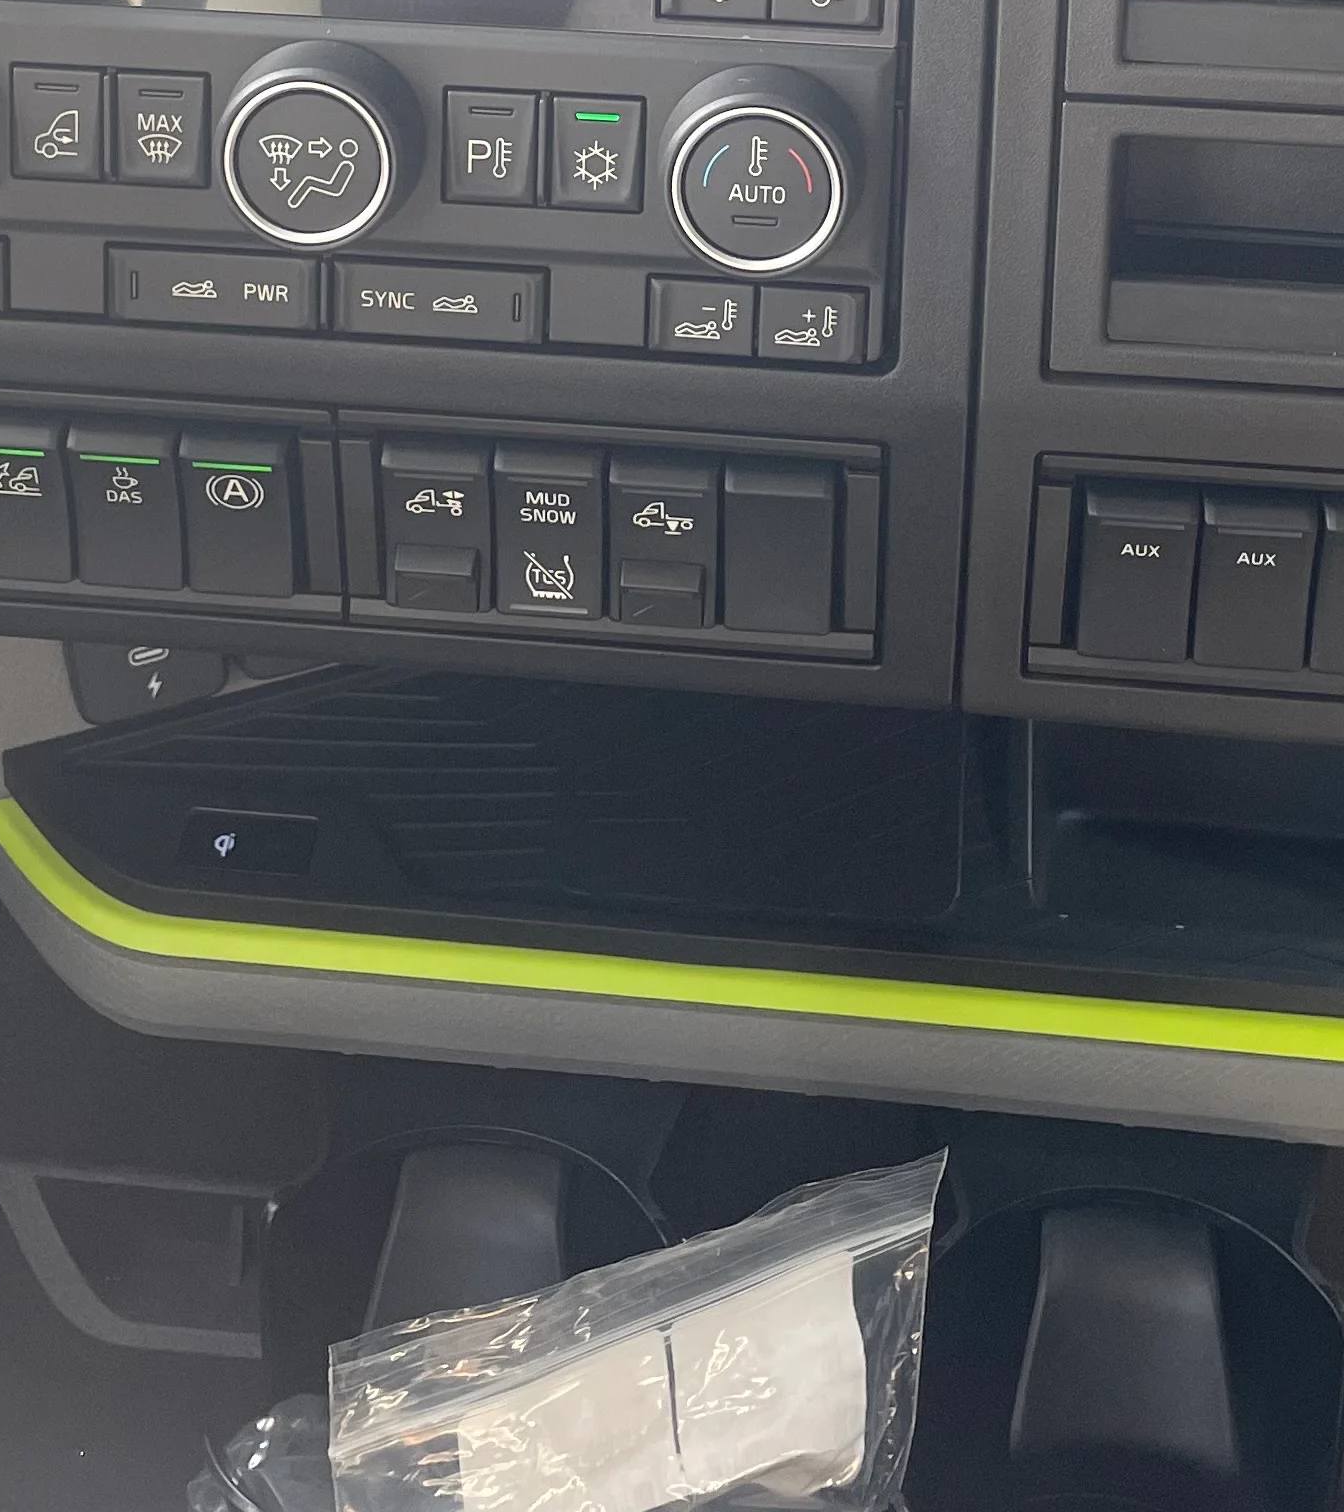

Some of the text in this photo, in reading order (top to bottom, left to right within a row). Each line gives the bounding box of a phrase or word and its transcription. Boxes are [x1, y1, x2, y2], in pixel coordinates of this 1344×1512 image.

[137, 112, 183, 134] MAX
[467, 139, 492, 174] P
[728, 183, 786, 204] AUTO
[244, 283, 289, 302] PWR
[360, 290, 415, 310] SYNC
[106, 488, 143, 505] DAS
[526, 491, 570, 507] MUD
[519, 507, 577, 525] SNOW
[1120, 543, 1160, 558] AUX
[1236, 552, 1276, 567] AUX
